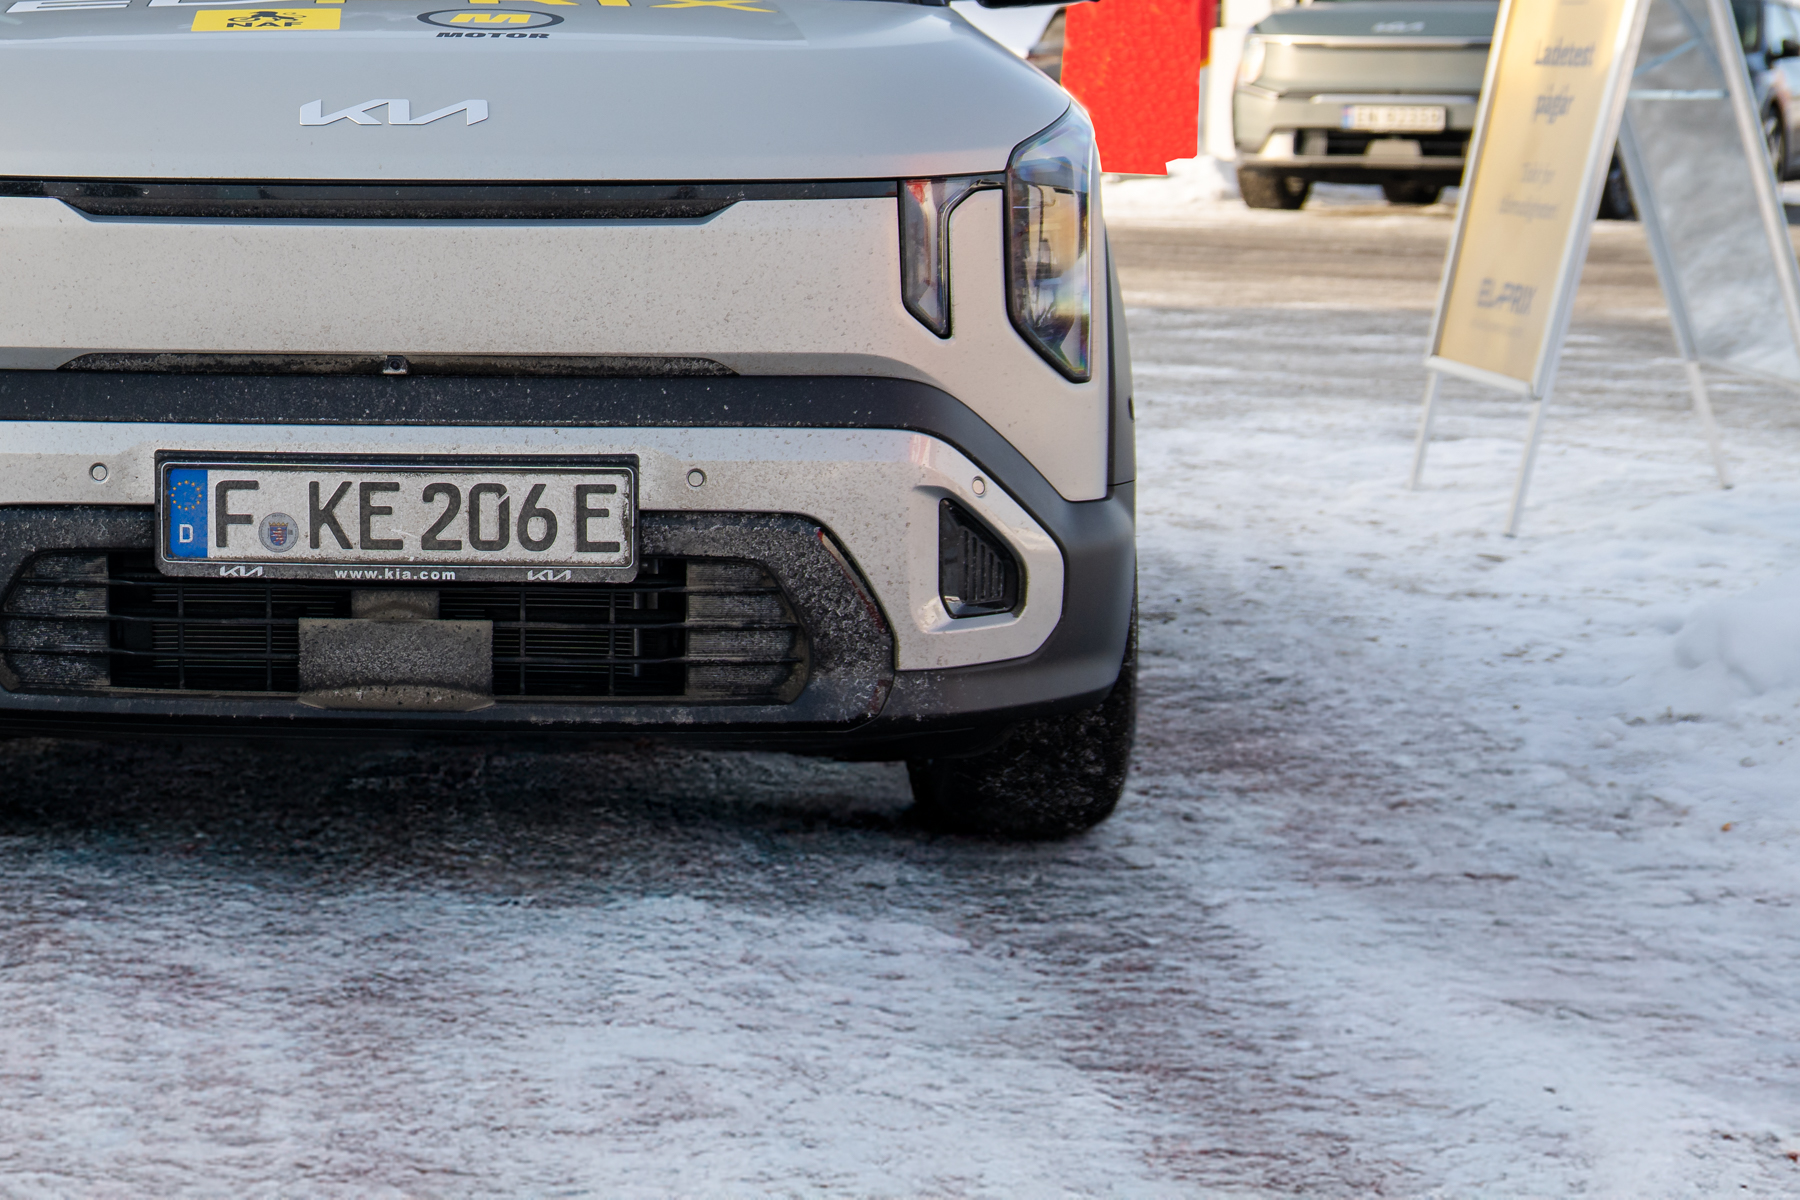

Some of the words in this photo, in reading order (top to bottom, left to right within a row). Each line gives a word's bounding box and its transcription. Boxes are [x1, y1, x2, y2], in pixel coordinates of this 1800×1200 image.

[299, 98, 490, 127] KIA
[215, 480, 260, 548] F
[179, 523, 194, 544] D
[219, 565, 264, 578] KIA
[334, 567, 456, 581] www.kia.com
[527, 569, 572, 582] KIA
